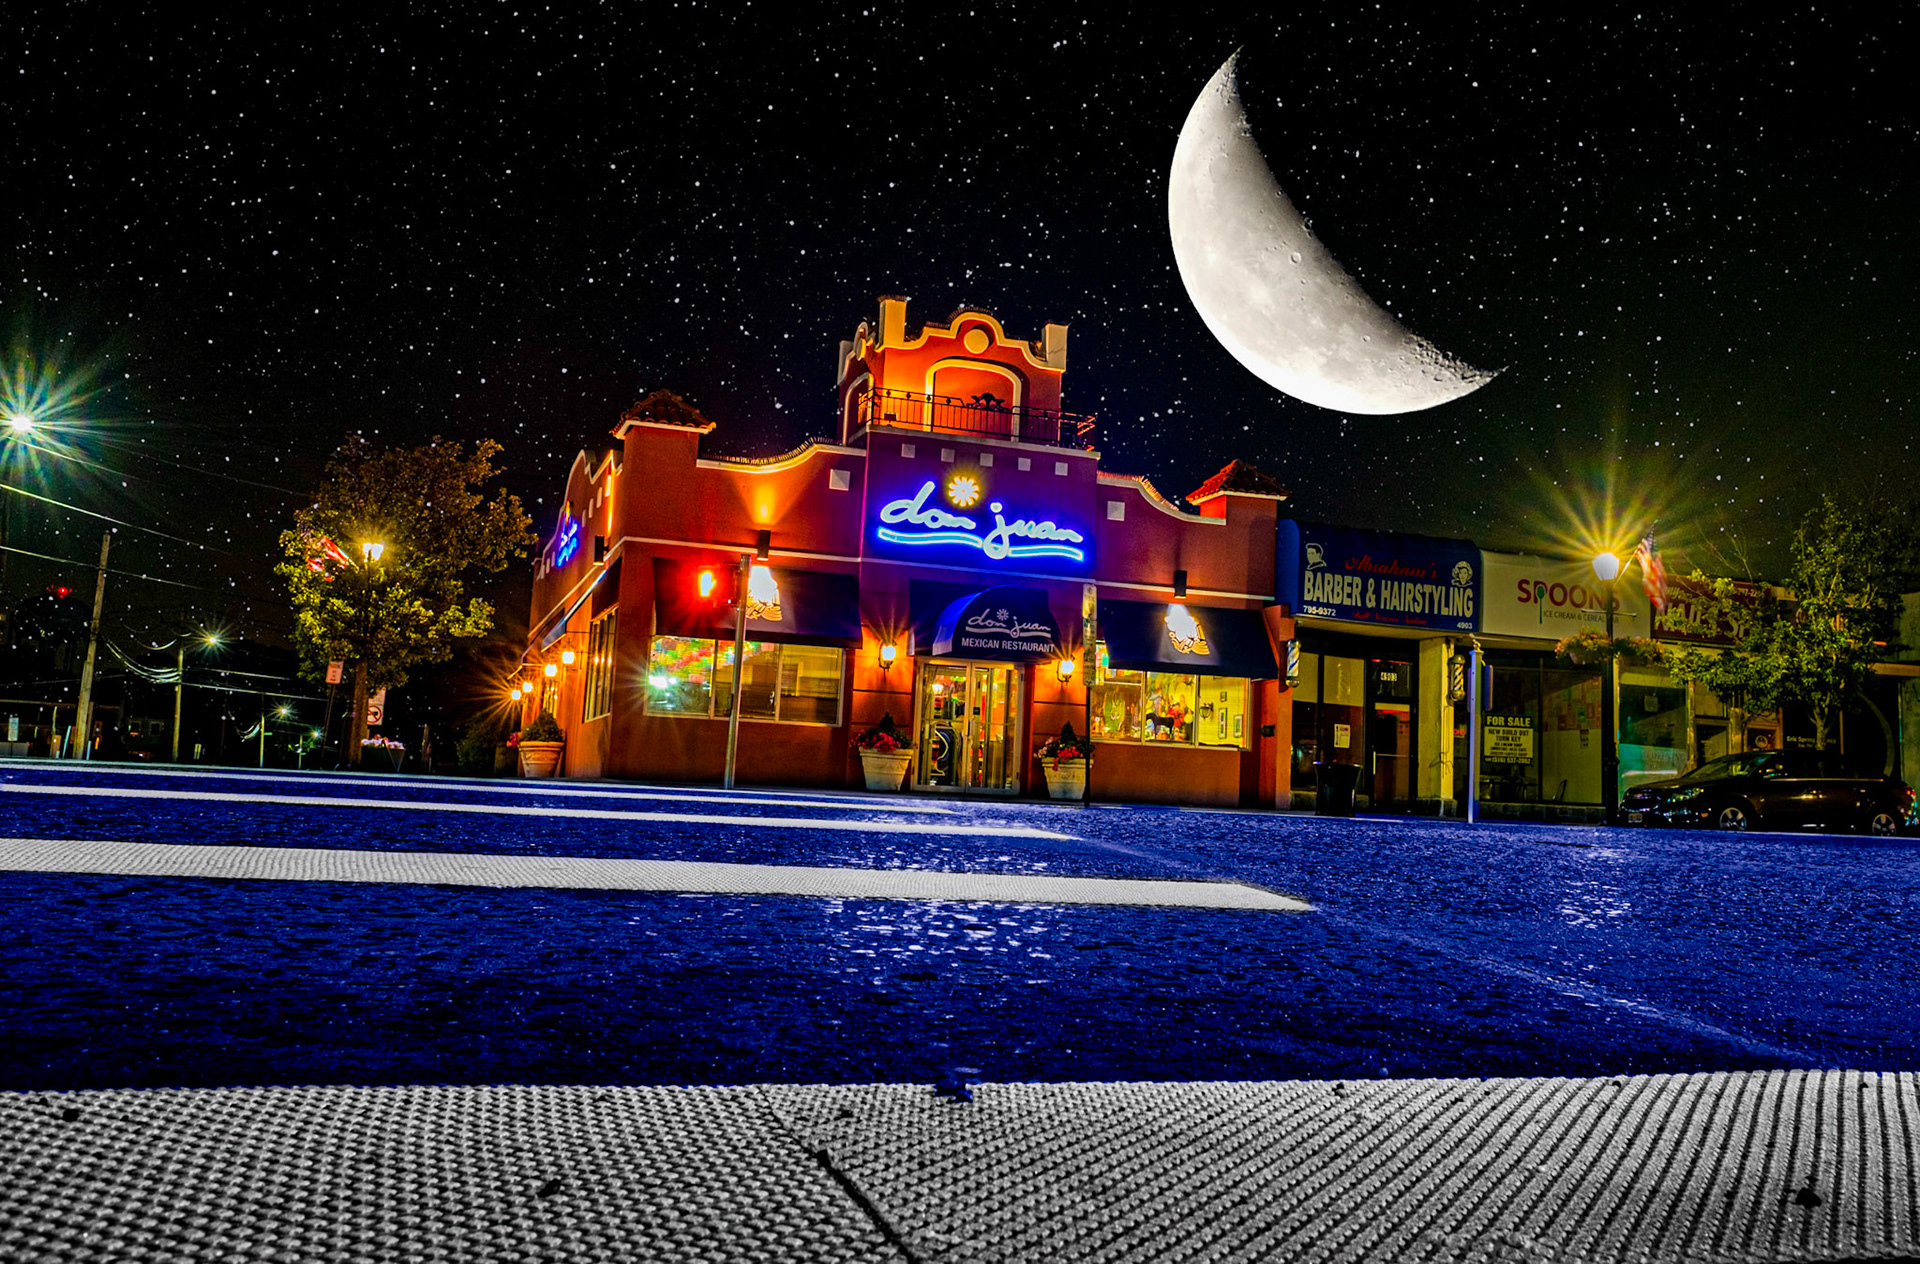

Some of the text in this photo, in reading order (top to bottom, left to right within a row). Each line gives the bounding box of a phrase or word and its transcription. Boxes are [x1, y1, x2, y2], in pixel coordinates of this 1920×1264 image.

[880, 480, 1084, 560] don juan
[1303, 570, 1362, 607] BARBER
[1366, 577, 1376, 608] &
[1380, 579, 1474, 619] HAIRSTYLING
[967, 608, 1051, 638] don juan
[1543, 609, 1552, 618] ICE
[1554, 611, 1576, 620] CREAM
[1577, 613, 1582, 621] &
[1583, 613, 1605, 622] CEREAL
[961, 637, 1055, 653] MEXICAN RESTAURANT
[1486, 716, 1531, 727] FOR SALE
